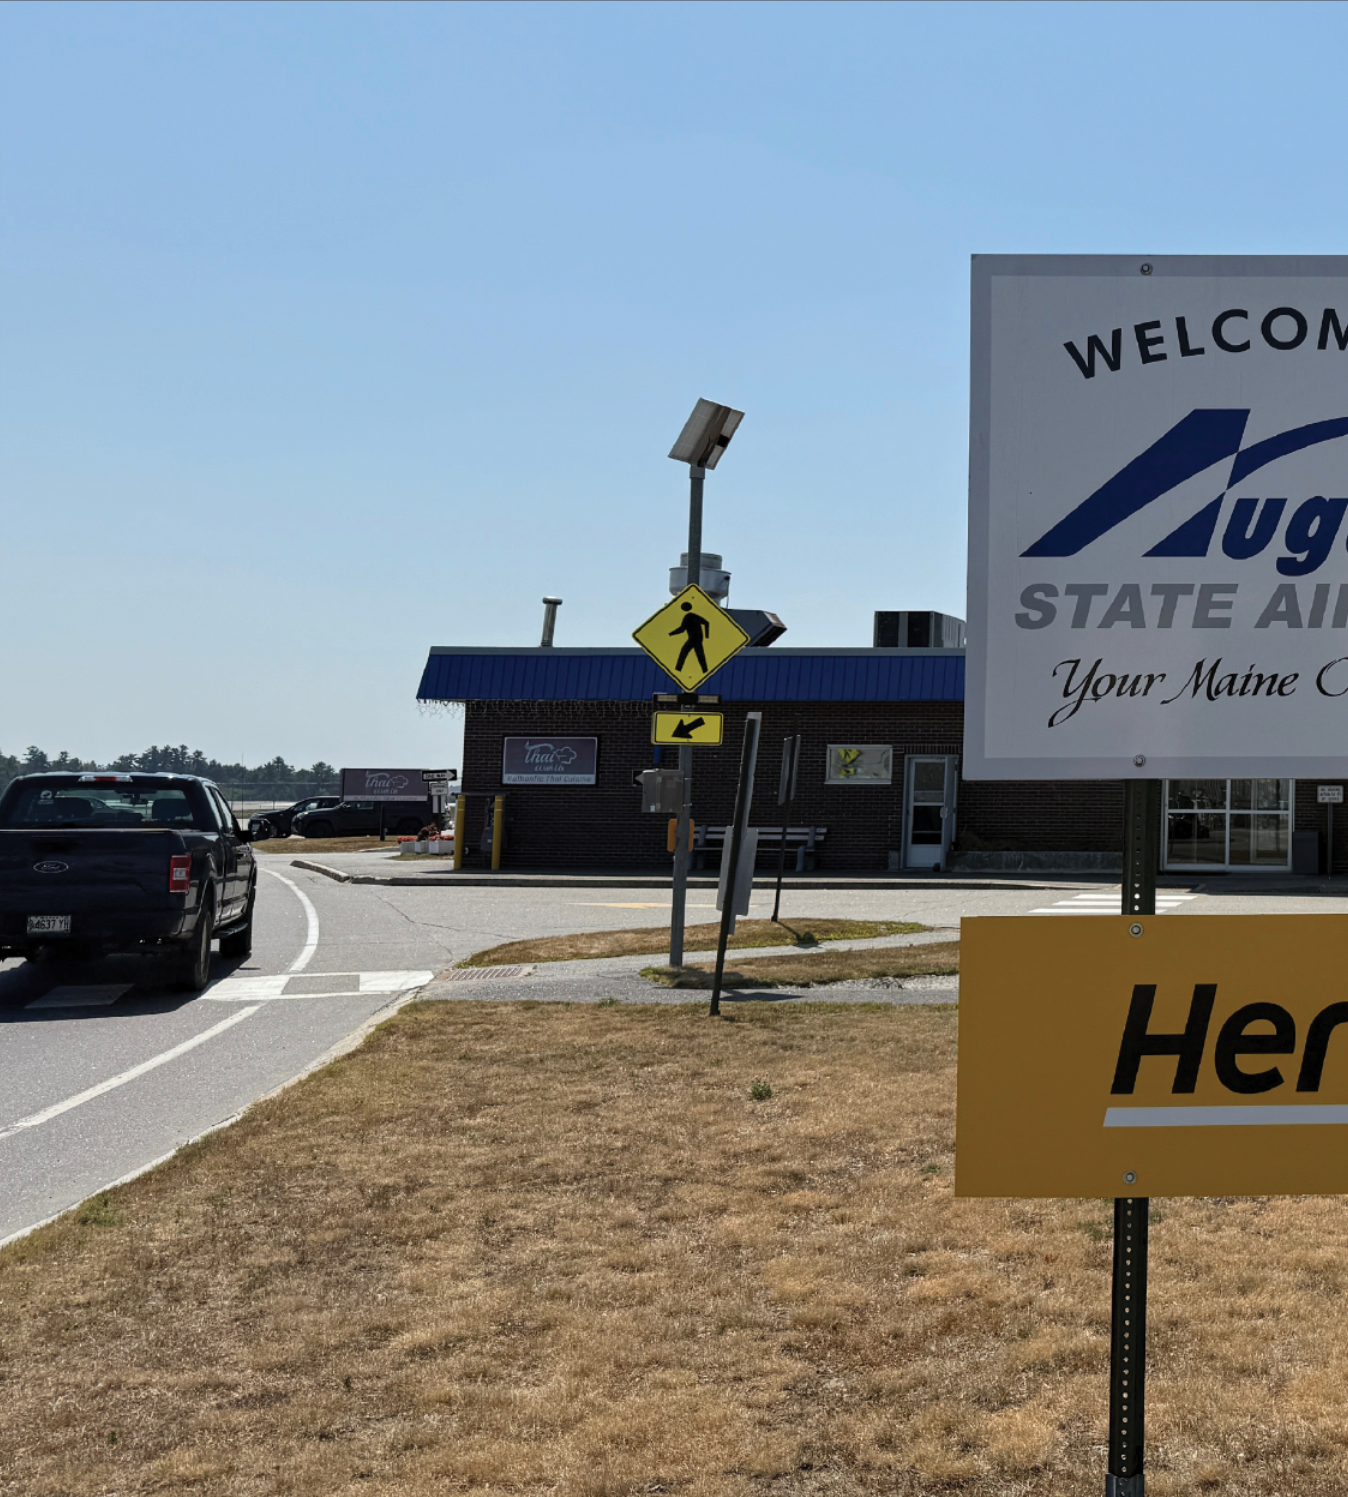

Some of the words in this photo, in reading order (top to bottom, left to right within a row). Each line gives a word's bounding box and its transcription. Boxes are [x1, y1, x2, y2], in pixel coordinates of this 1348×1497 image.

[1014, 582, 1238, 630] STATE
[1047, 657, 1166, 729] Your
[1161, 655, 1300, 706] Maine
[524, 740, 555, 764] Thai
[365, 771, 391, 788] Thai
